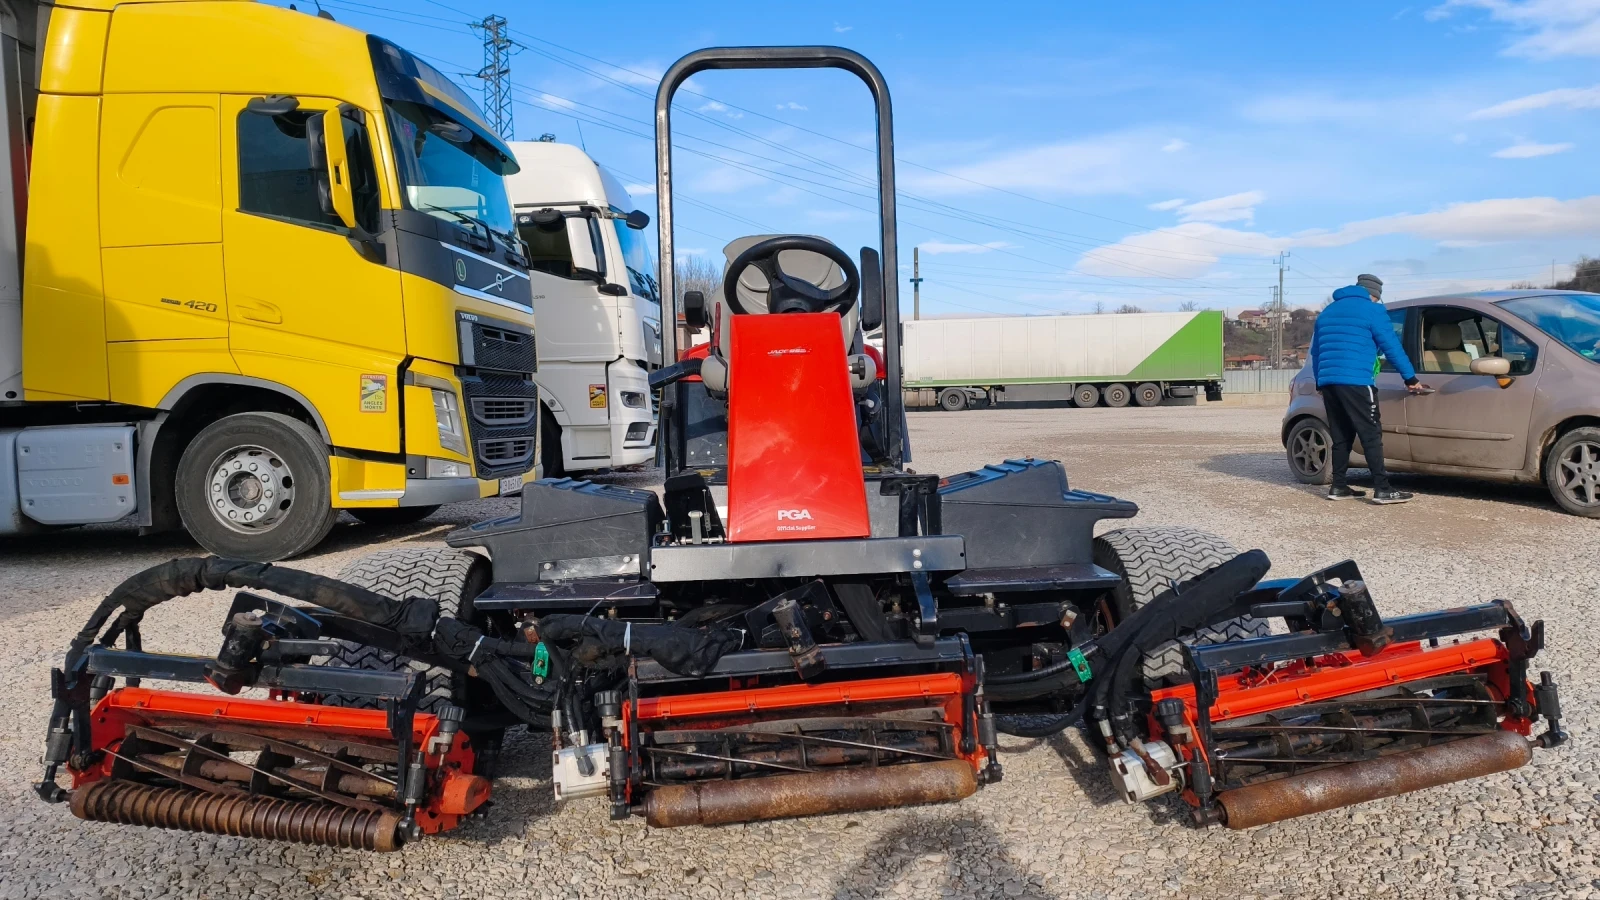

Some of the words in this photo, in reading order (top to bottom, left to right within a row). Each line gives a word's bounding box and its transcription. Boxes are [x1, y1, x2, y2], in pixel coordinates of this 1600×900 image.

[184, 300, 217, 312] 420
[460, 312, 478, 321] VOLVO
[777, 509, 812, 521] PGA
